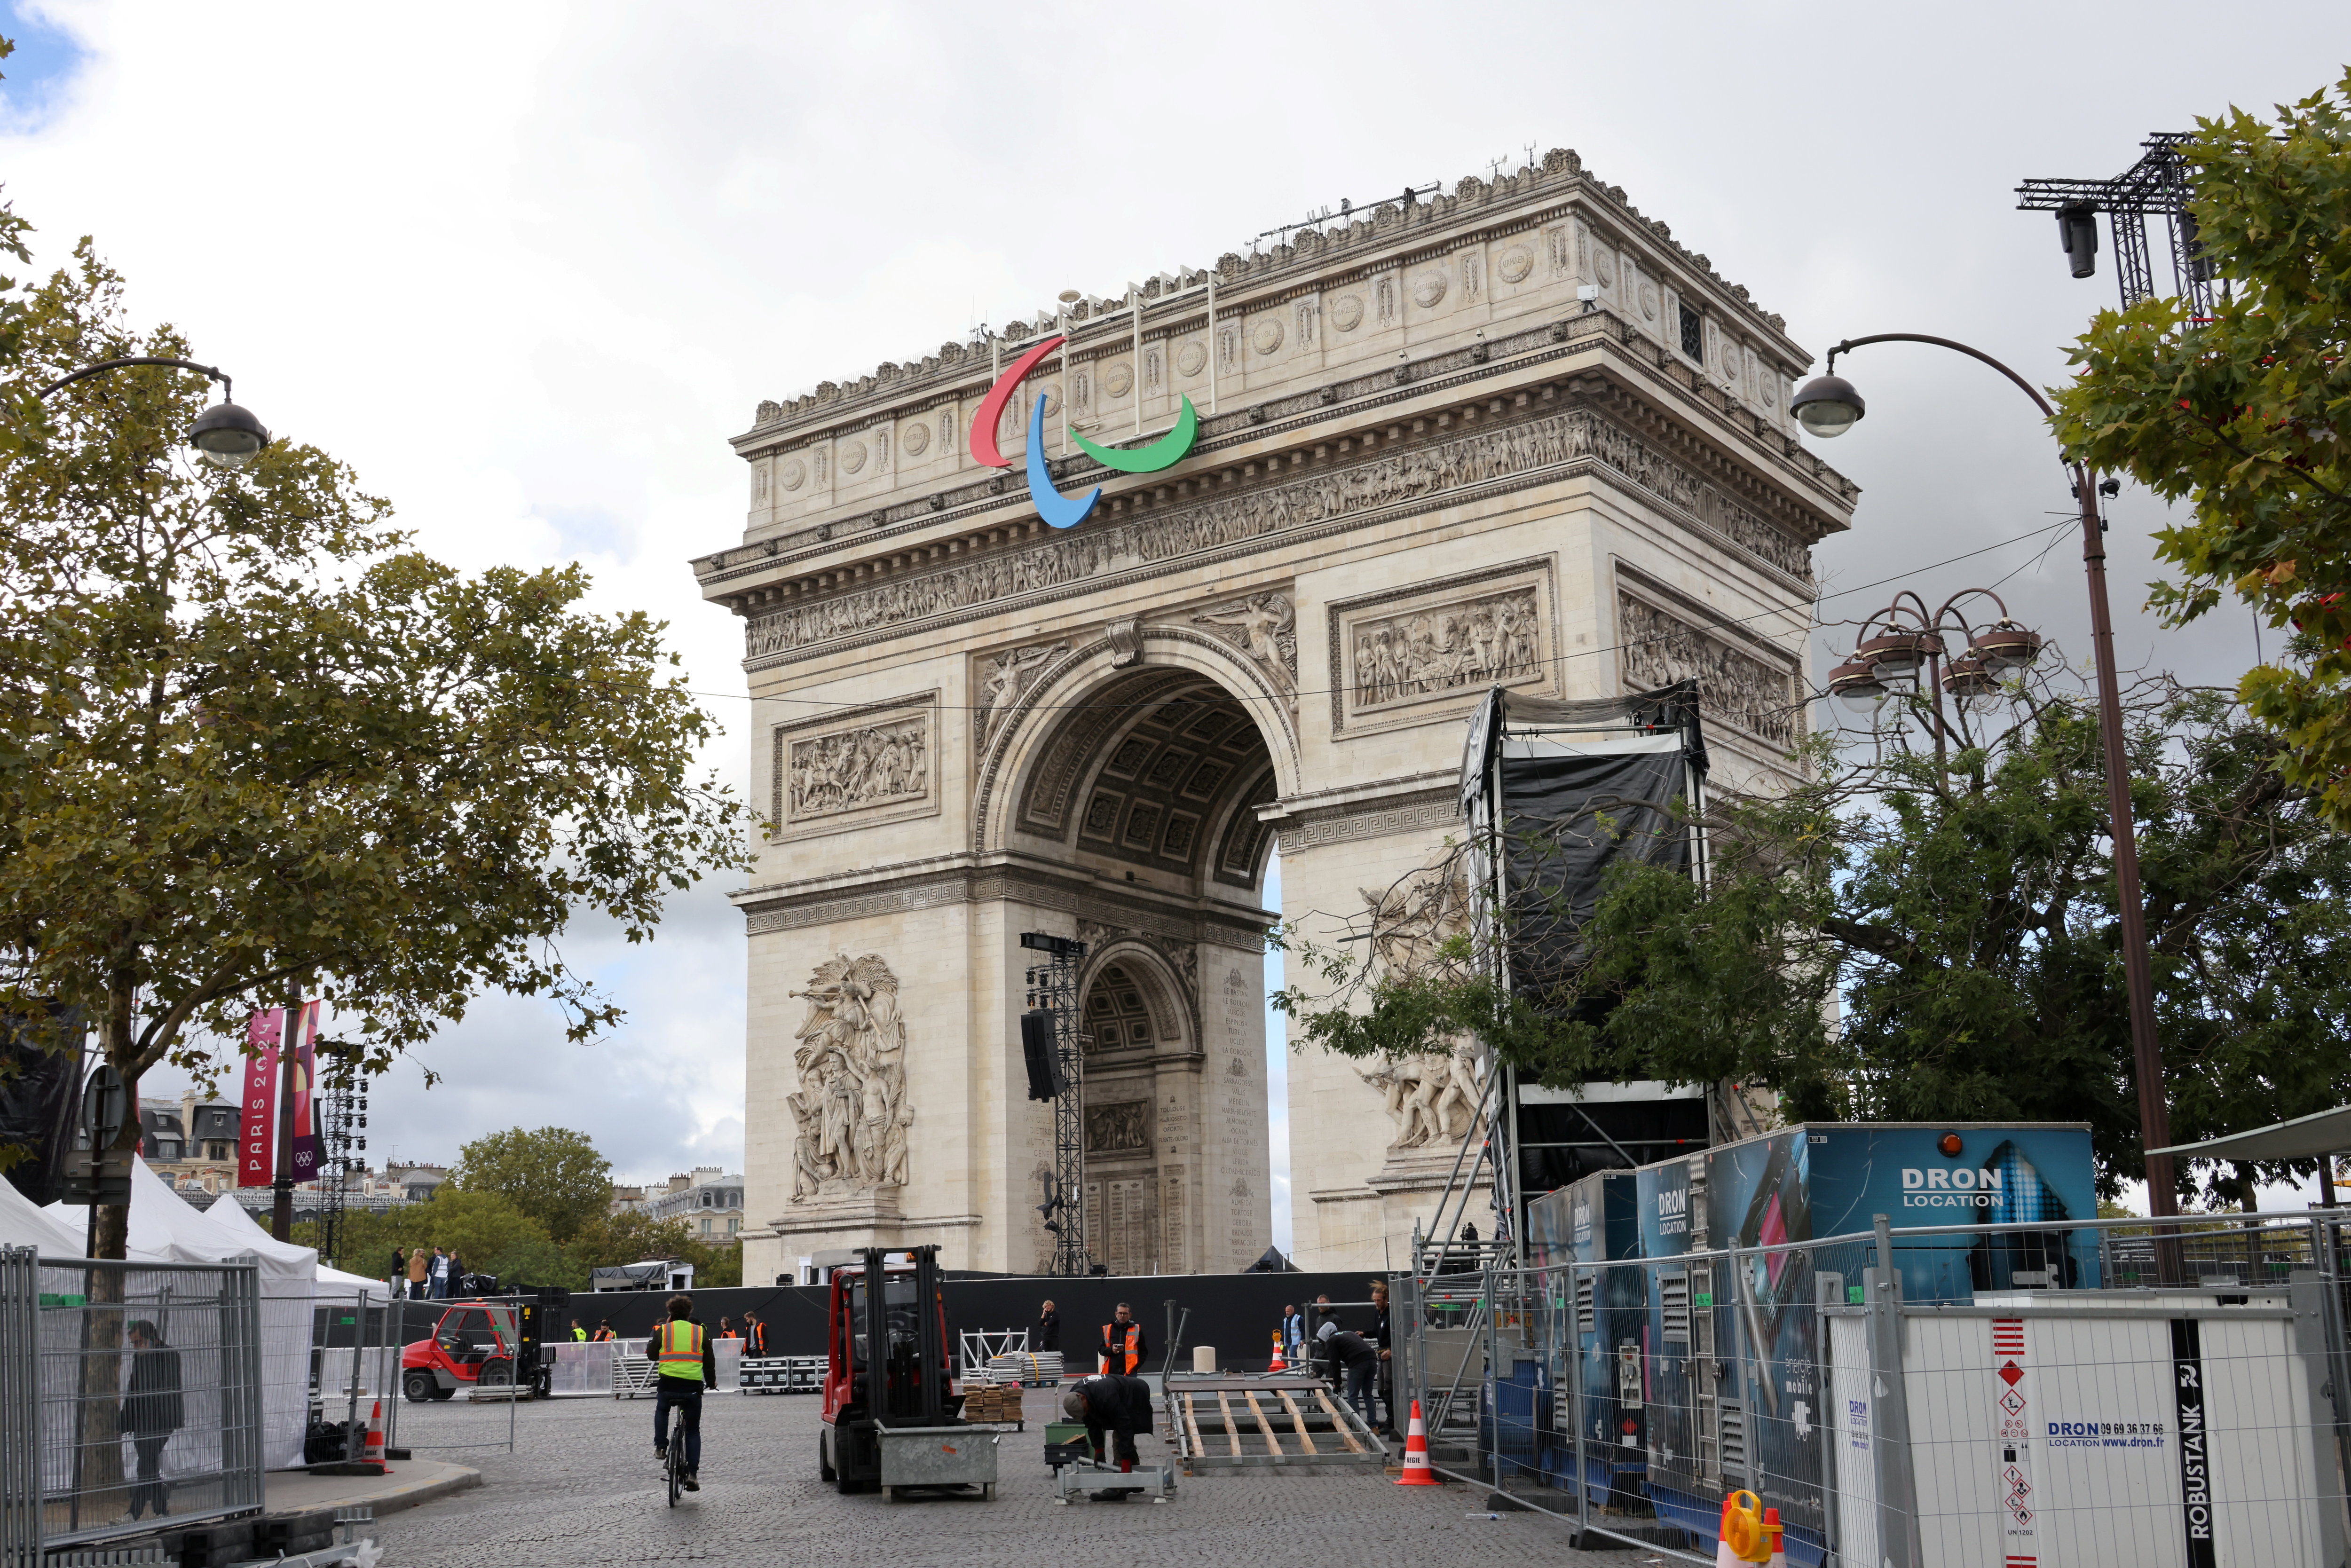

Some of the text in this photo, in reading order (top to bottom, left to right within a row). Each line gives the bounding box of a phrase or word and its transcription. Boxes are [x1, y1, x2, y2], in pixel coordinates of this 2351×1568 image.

[1503, 255, 1524, 268] ALKMAER
[1416, 281, 1438, 294] ABOUKIR
[1256, 329, 1275, 341] RIVOLI
[1180, 352, 1199, 362] ARCOLE
[905, 433, 923, 443] FLEURUS
[1231, 988, 1248, 998] BASTAN
[1230, 999, 1249, 1008] BOULOU
[1225, 1017, 1248, 1027] ESPINOSA
[1228, 1027, 1247, 1037] TUDELA
[1230, 1037, 1245, 1046] UCLEZ
[1230, 1048, 1253, 1057] COROGNE
[1229, 1098, 1250, 1106] MEDELIN
[1226, 1117, 1253, 1127] ALMONACID
[1902, 1168, 2003, 1189] DRON
[1659, 1189, 1686, 1215] DRON
[1903, 1195, 2004, 1207] LOCATION
[1231, 1208, 1253, 1217] TORTOSE
[1575, 1204, 1590, 1227] DRON
[1660, 1220, 1687, 1235] LOCATION
[1575, 1230, 1591, 1243] LOCATION
[1785, 1353, 1811, 1378] énergie
[1786, 1378, 1812, 1395] mobile
[1849, 1400, 1867, 1415] DRON
[2048, 1422, 2163, 1435] DRON 09 69 36 37 66
[2102, 1436, 2164, 1447] www.dron.fr
[2182, 1403, 2209, 1539] ROBUSTANK
